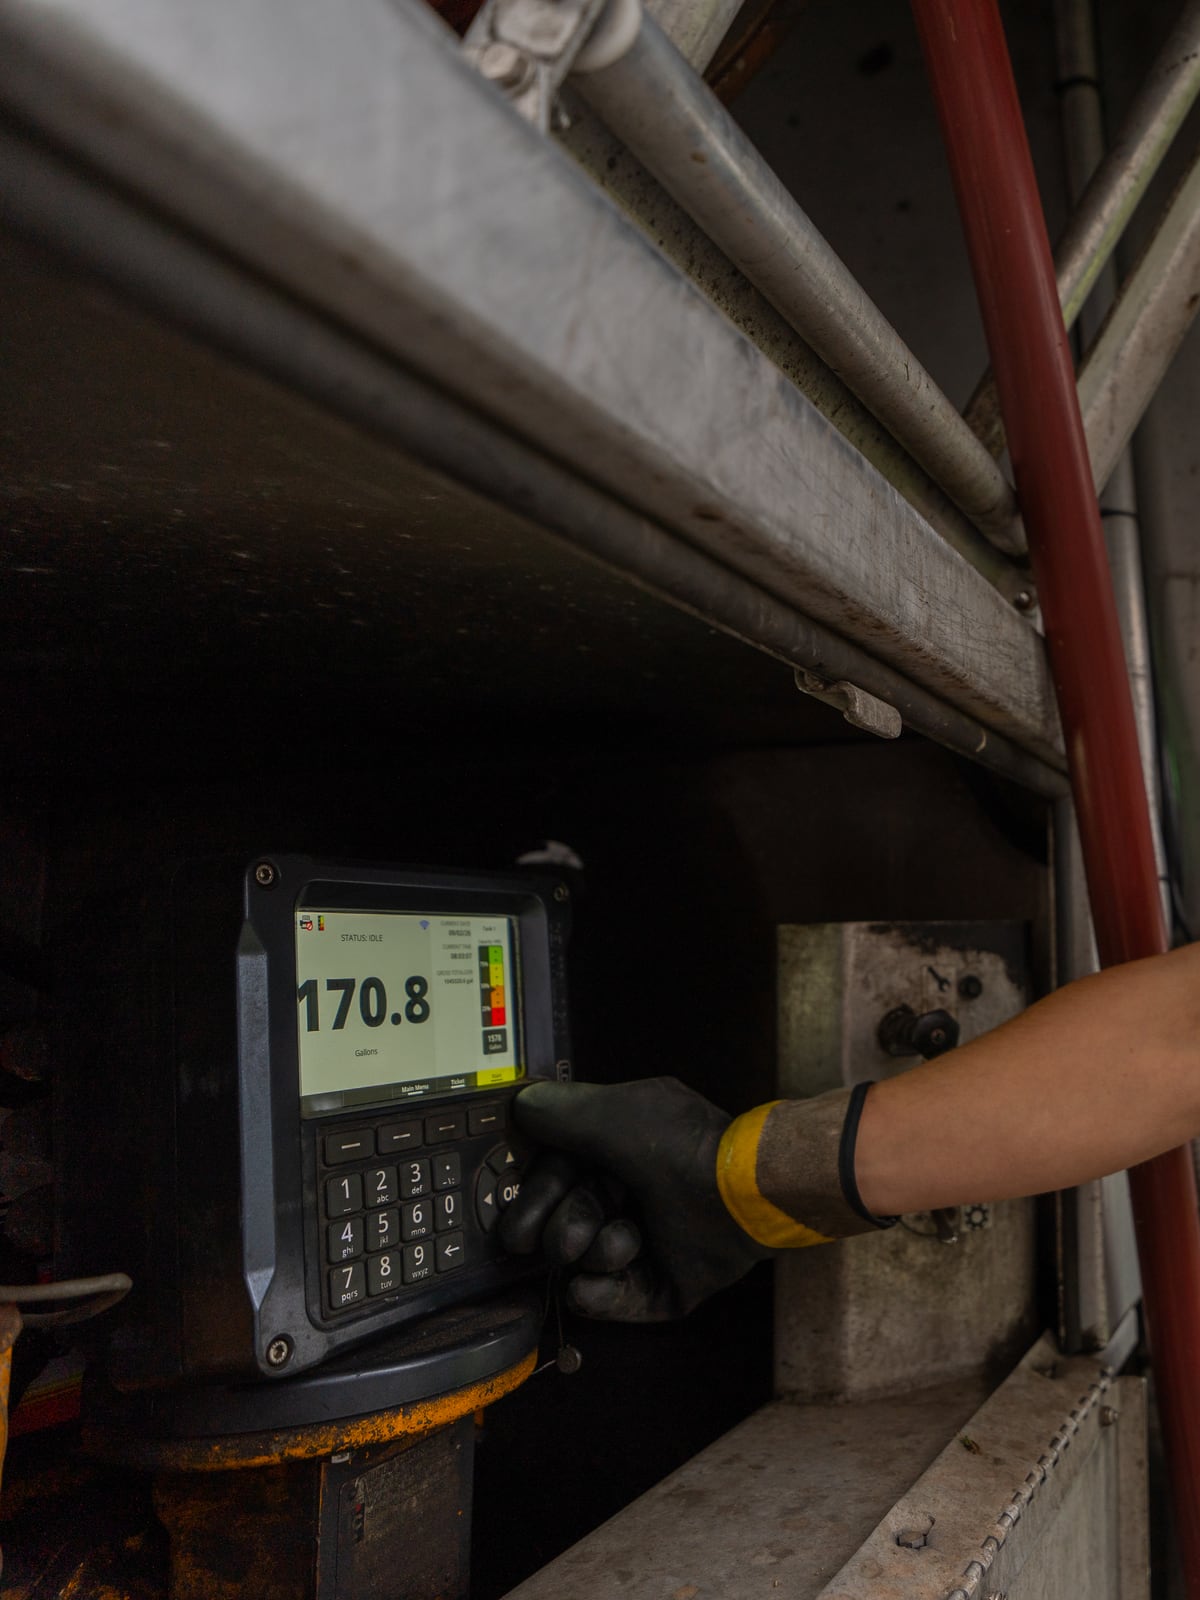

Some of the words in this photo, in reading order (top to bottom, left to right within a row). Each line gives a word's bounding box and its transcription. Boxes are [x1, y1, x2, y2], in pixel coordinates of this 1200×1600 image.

[341, 934, 367, 942] STATUS:
[369, 934, 383, 942] IDLE
[298, 975, 430, 1032] 170.8
[355, 1048, 378, 1057] Gallons
[376, 1170, 388, 1191] 2
[410, 1163, 421, 1183] 3
[341, 1178, 350, 1199] 1
[411, 1184, 424, 1195] def
[503, 1184, 520, 1202] OK
[376, 1194, 390, 1204] abc
[444, 1195, 454, 1214] 0
[378, 1212, 389, 1233] 5
[412, 1203, 423, 1224] 6
[341, 1222, 354, 1243] 4
[411, 1226, 426, 1237] mno
[379, 1236, 389, 1248] jkl
[342, 1246, 354, 1258] ghi
[414, 1245, 424, 1266] 9
[380, 1256, 391, 1277] 8
[411, 1267, 429, 1279] wxyz
[342, 1266, 353, 1289] 7
[380, 1279, 393, 1290] tuv
[341, 1289, 358, 1304] pqrs
